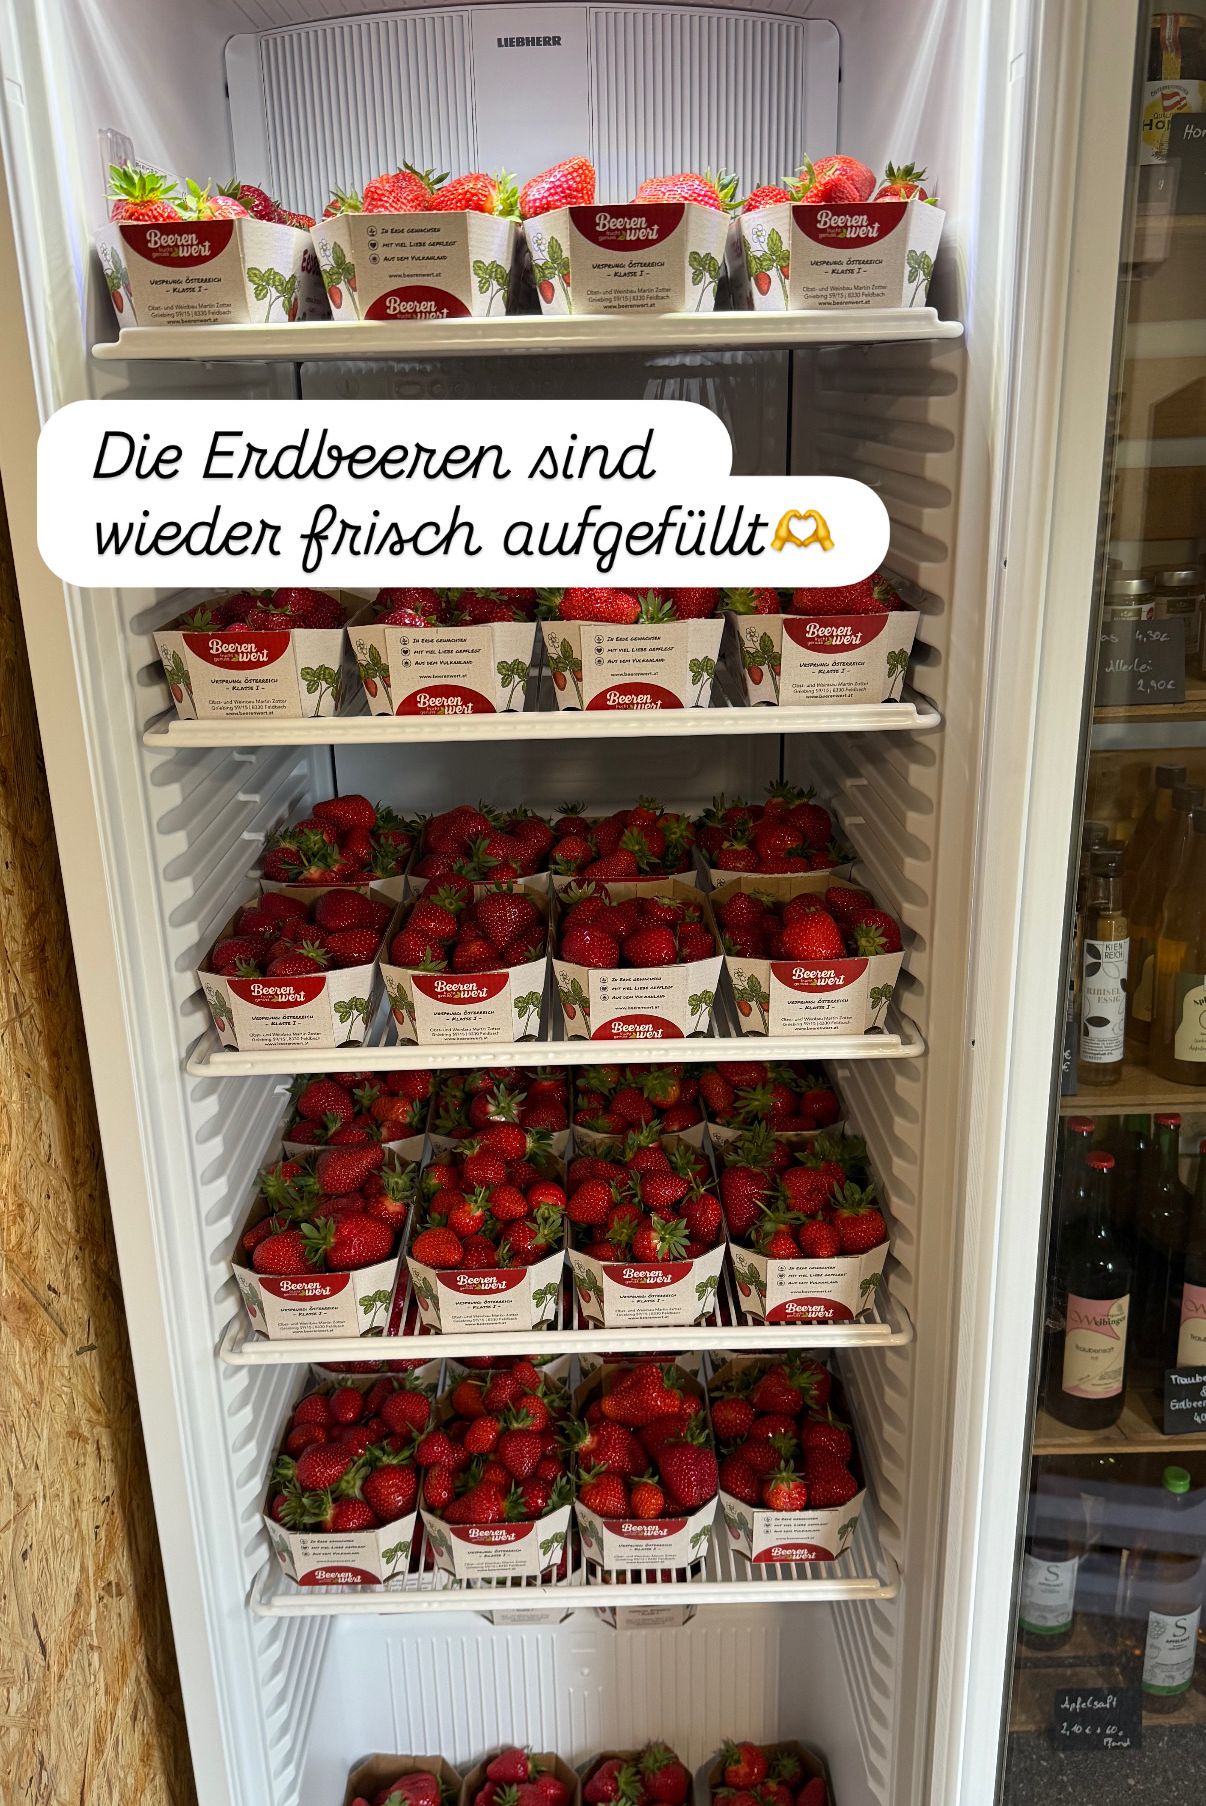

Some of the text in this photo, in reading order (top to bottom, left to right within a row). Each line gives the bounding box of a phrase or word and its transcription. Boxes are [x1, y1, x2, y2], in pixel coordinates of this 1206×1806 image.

[497, 36, 562, 48] LIEBHERR
[595, 212, 647, 232] Beeren
[816, 210, 868, 229] Beeren
[625, 224, 660, 241] wert
[846, 222, 880, 238] wert
[146, 229, 198, 248] Beeren
[179, 241, 211, 257] wert
[386, 297, 437, 315] Beeren
[805, 622, 853, 638] Beeren
[832, 632, 863, 645] wert
[208, 639, 257, 654] Beeren
[238, 649, 269, 661] wert
[416, 693, 463, 708] Beeren
[606, 690, 652, 705] Beeren
[444, 702, 474, 714] wert
[1105, 942, 1123, 952] KIEN
[1104, 950, 1123, 959] REICH
[792, 967, 836, 980] Beeren
[434, 980, 478, 992] Beeren
[816, 974, 846, 986] wert
[250, 983, 295, 996] Beeren
[460, 987, 488, 998] wert
[278, 991, 306, 1002] wert
[611, 1021, 654, 1033] Beeren
[636, 1028, 664, 1039] wert
[623, 1268, 664, 1279] Beeren
[646, 1274, 673, 1284] wert
[279, 1280, 322, 1292] Beeren
[456, 1274, 498, 1286] Beeren
[481, 1280, 507, 1290] wert
[305, 1286, 331, 1296] wert
[785, 1302, 826, 1313] Beeren
[807, 1308, 835, 1318] wert
[468, 1528, 507, 1538] Beeren
[621, 1523, 660, 1532] Beeren
[643, 1528, 669, 1536] wert
[491, 1532, 516, 1541] wert
[771, 1547, 809, 1556] Beeren
[792, 1551, 817, 1560] wert
[314, 1570, 353, 1580] Beeren
[337, 1575, 362, 1583] wert
[1045, 1564, 1061, 1582] S
[1172, 1617, 1187, 1638] S
[1060, 1694, 1117, 1712] Apfelsaft
